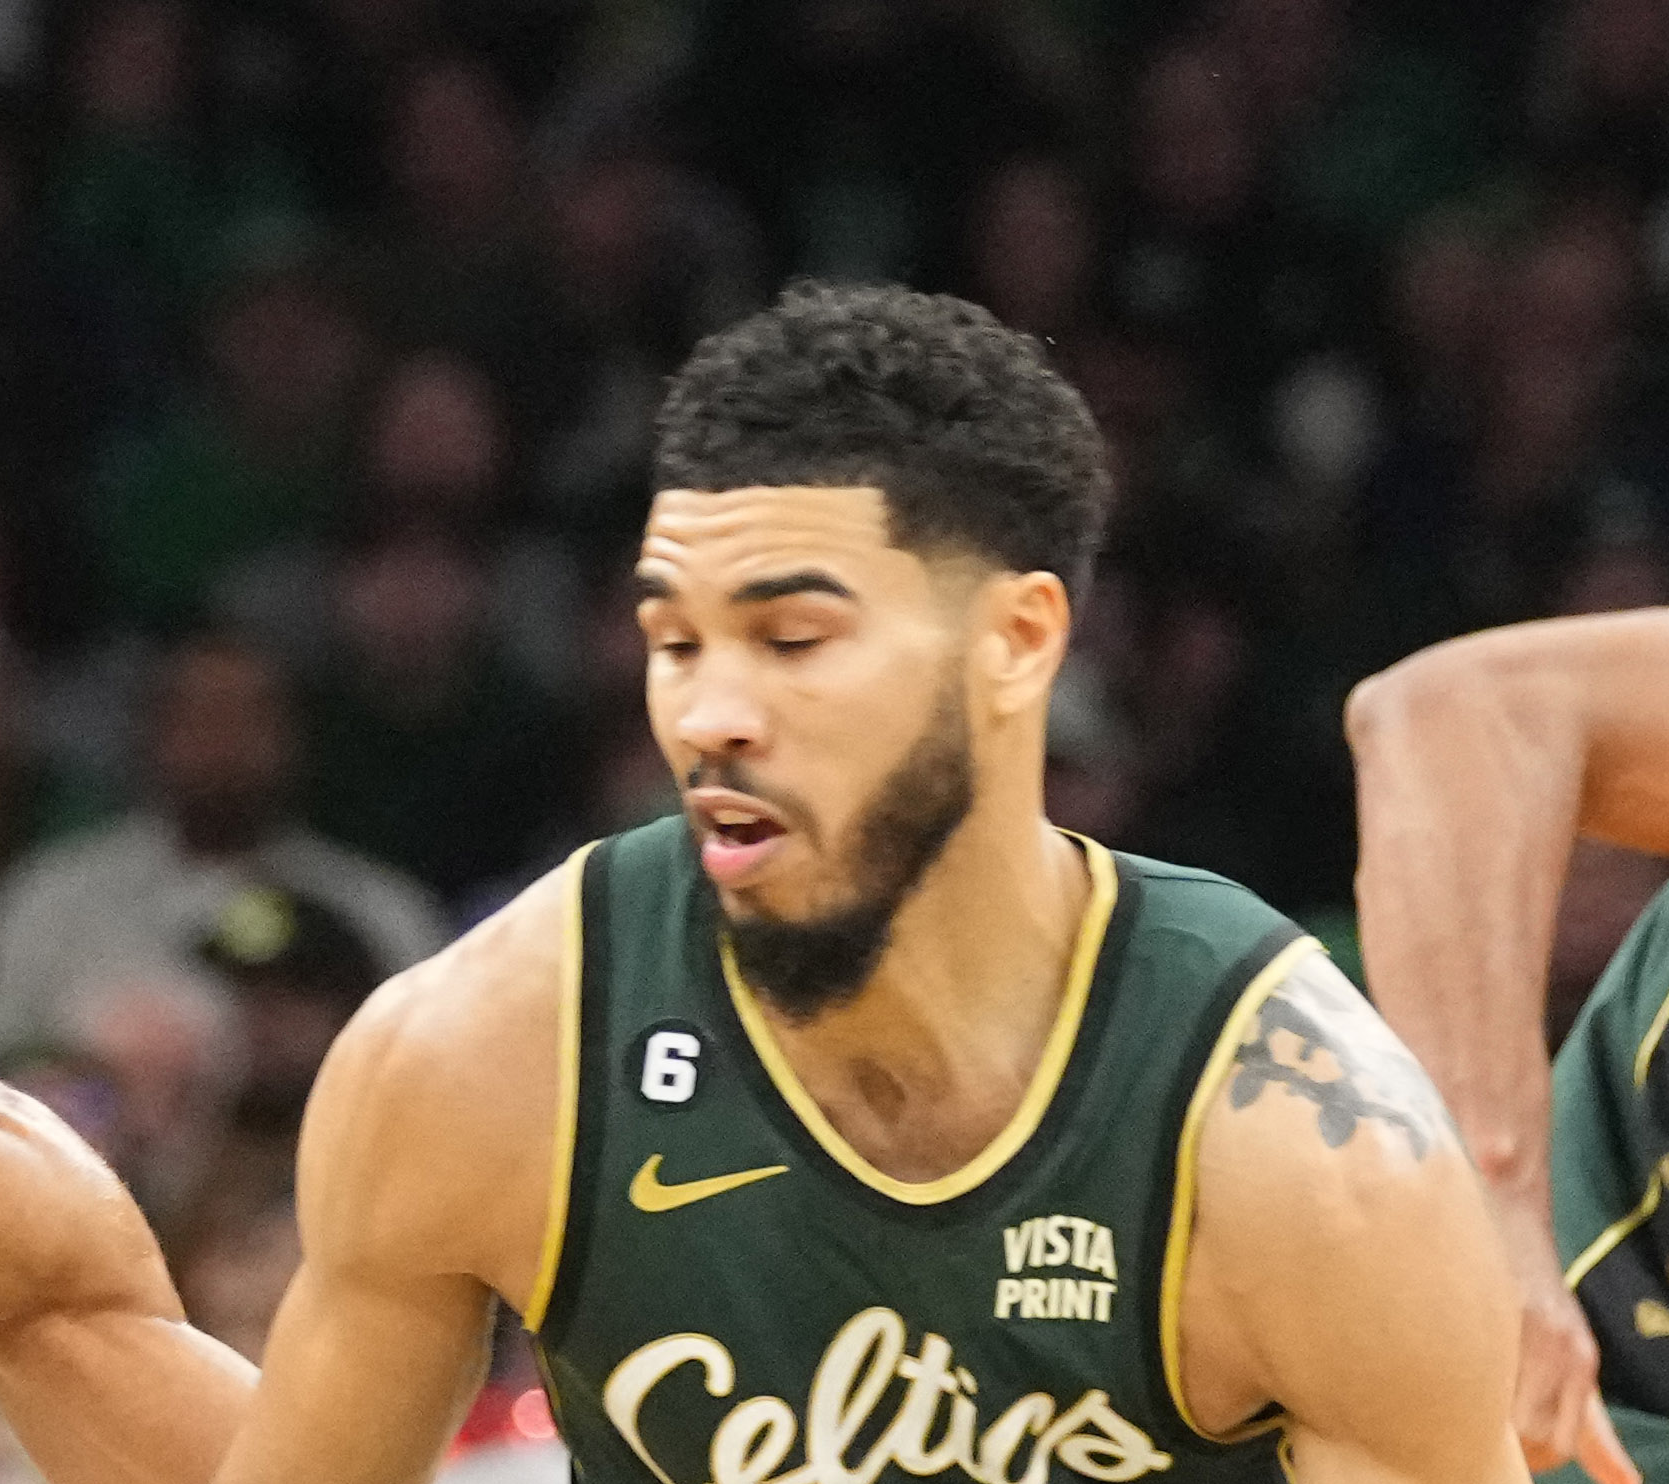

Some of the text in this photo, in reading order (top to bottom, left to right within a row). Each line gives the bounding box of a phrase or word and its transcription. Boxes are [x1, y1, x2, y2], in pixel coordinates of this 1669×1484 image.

[641, 1031, 701, 1103] 6
[1002, 1214, 1117, 1277] VISTA
[994, 1277, 1118, 1322] PRINT
